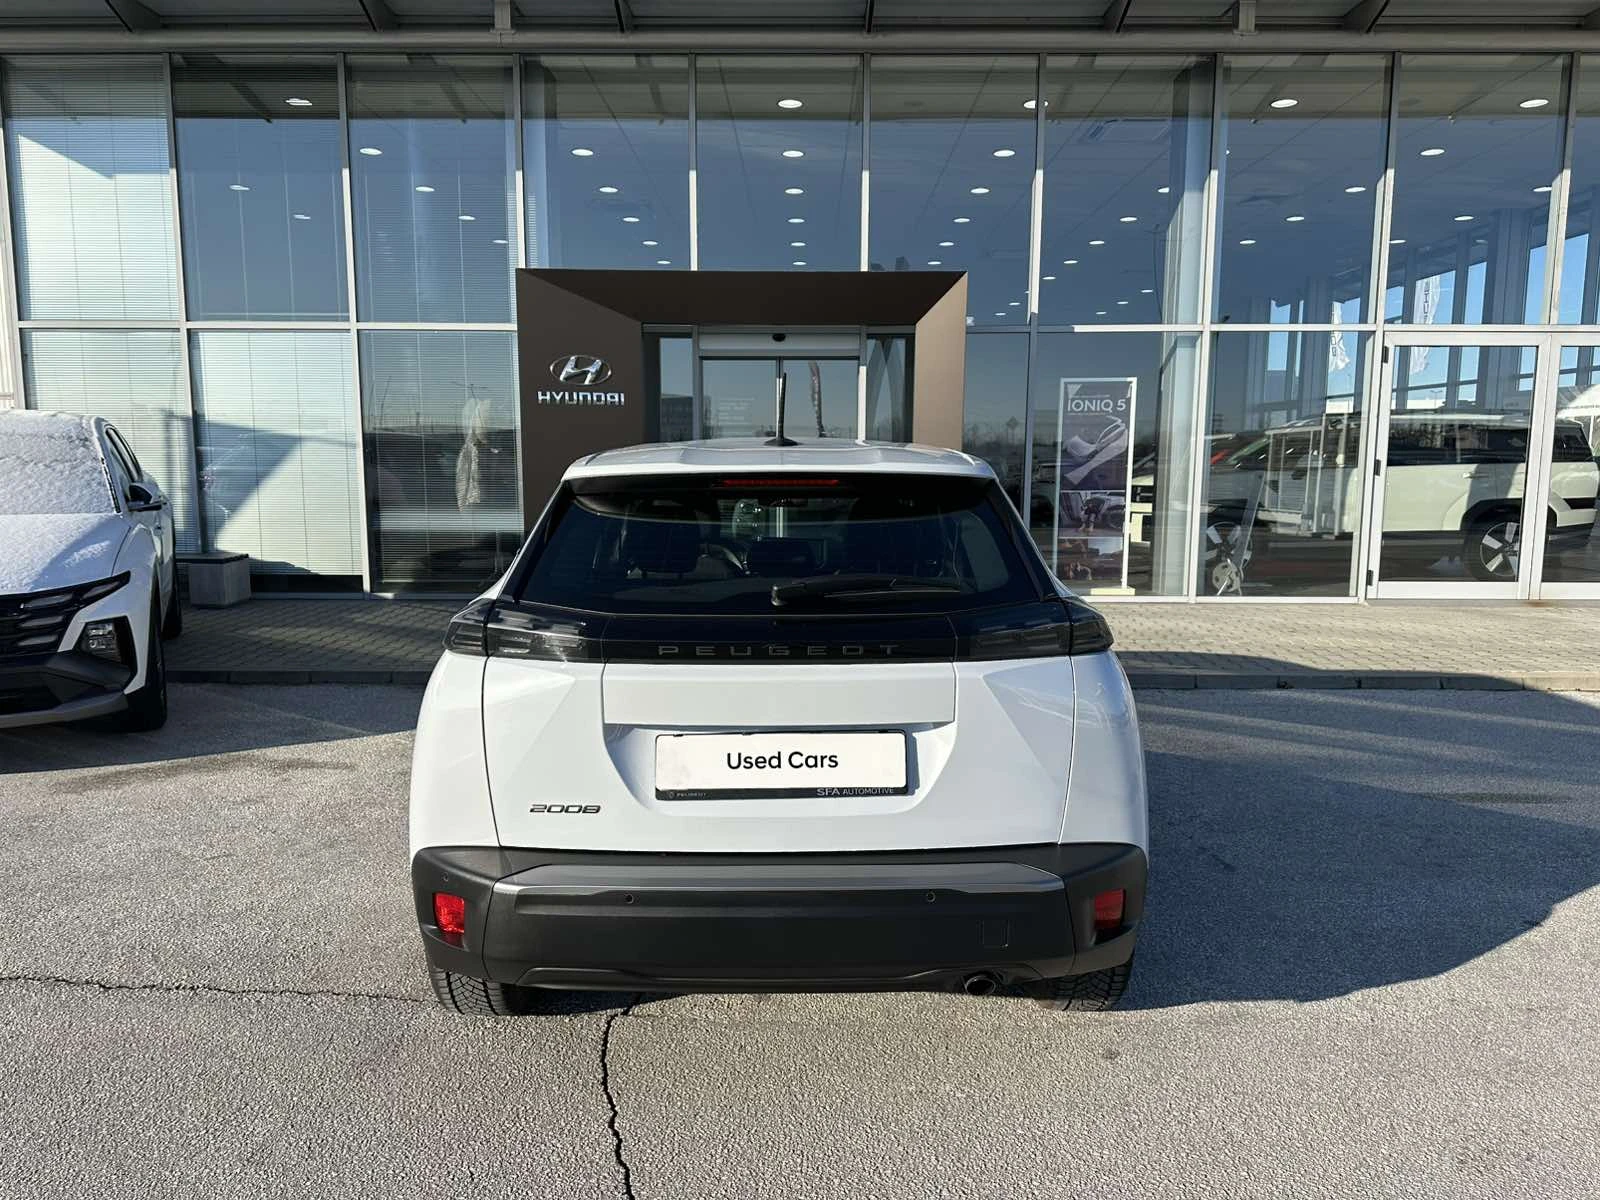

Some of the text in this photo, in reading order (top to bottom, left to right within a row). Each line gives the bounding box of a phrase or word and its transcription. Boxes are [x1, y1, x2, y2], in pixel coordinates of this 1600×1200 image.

[537, 391, 625, 406] HYUNDAI
[1067, 398, 1127, 413] IONIQ 5
[657, 644, 900, 656] PEUGEOT
[726, 751, 839, 769] Used Cars
[816, 786, 895, 796] SFA AUTOMOTIVE
[529, 803, 601, 814] 2008
